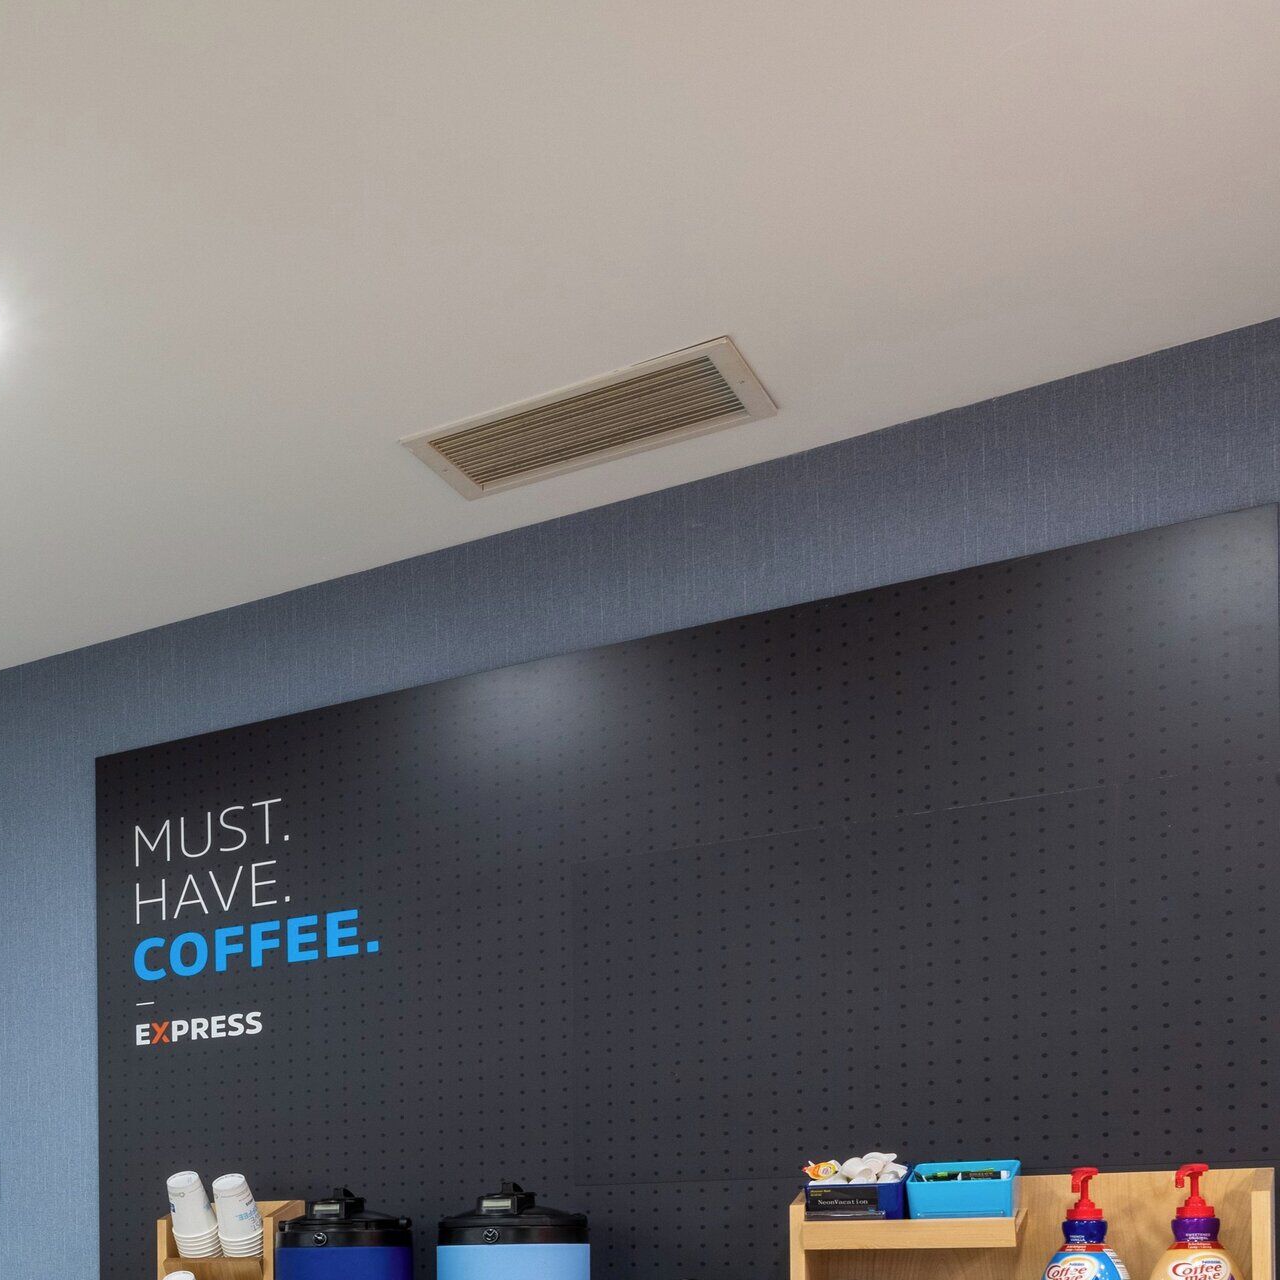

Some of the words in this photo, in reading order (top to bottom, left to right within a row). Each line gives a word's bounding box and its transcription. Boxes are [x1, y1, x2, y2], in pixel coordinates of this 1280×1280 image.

[135, 798, 290, 867] MUST.
[135, 860, 291, 925] HAVE.
[133, 908, 380, 981] COFFEE.
[135, 1011, 263, 1046] EXPRESS
[1046, 1264, 1088, 1280] Coffee
[1172, 1263, 1223, 1277] Coffee
